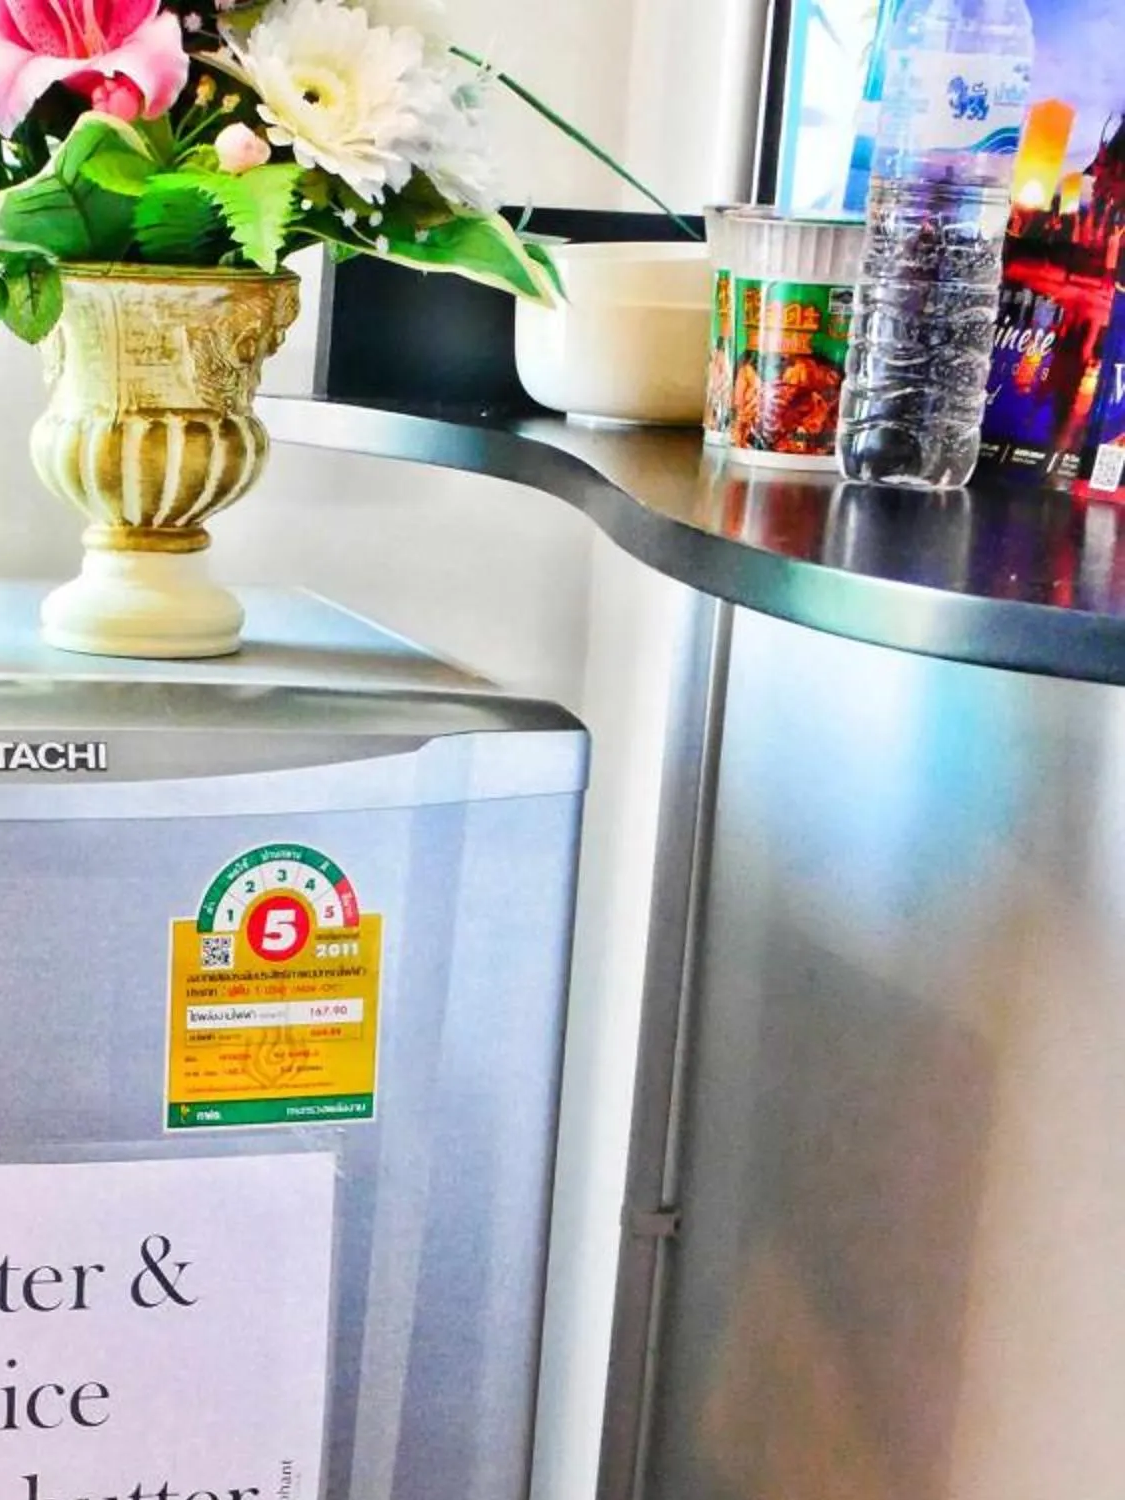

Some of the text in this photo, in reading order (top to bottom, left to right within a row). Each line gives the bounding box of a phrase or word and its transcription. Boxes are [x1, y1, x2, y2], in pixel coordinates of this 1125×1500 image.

[277, 870, 287, 882] 3
[245, 881, 256, 893] 2
[304, 878, 316, 891] 4
[226, 909, 234, 922] 1
[323, 906, 335, 919] 5
[261, 908, 298, 952] 5
[316, 942, 360, 960] 2011
[130, 1233, 199, 1309] &
